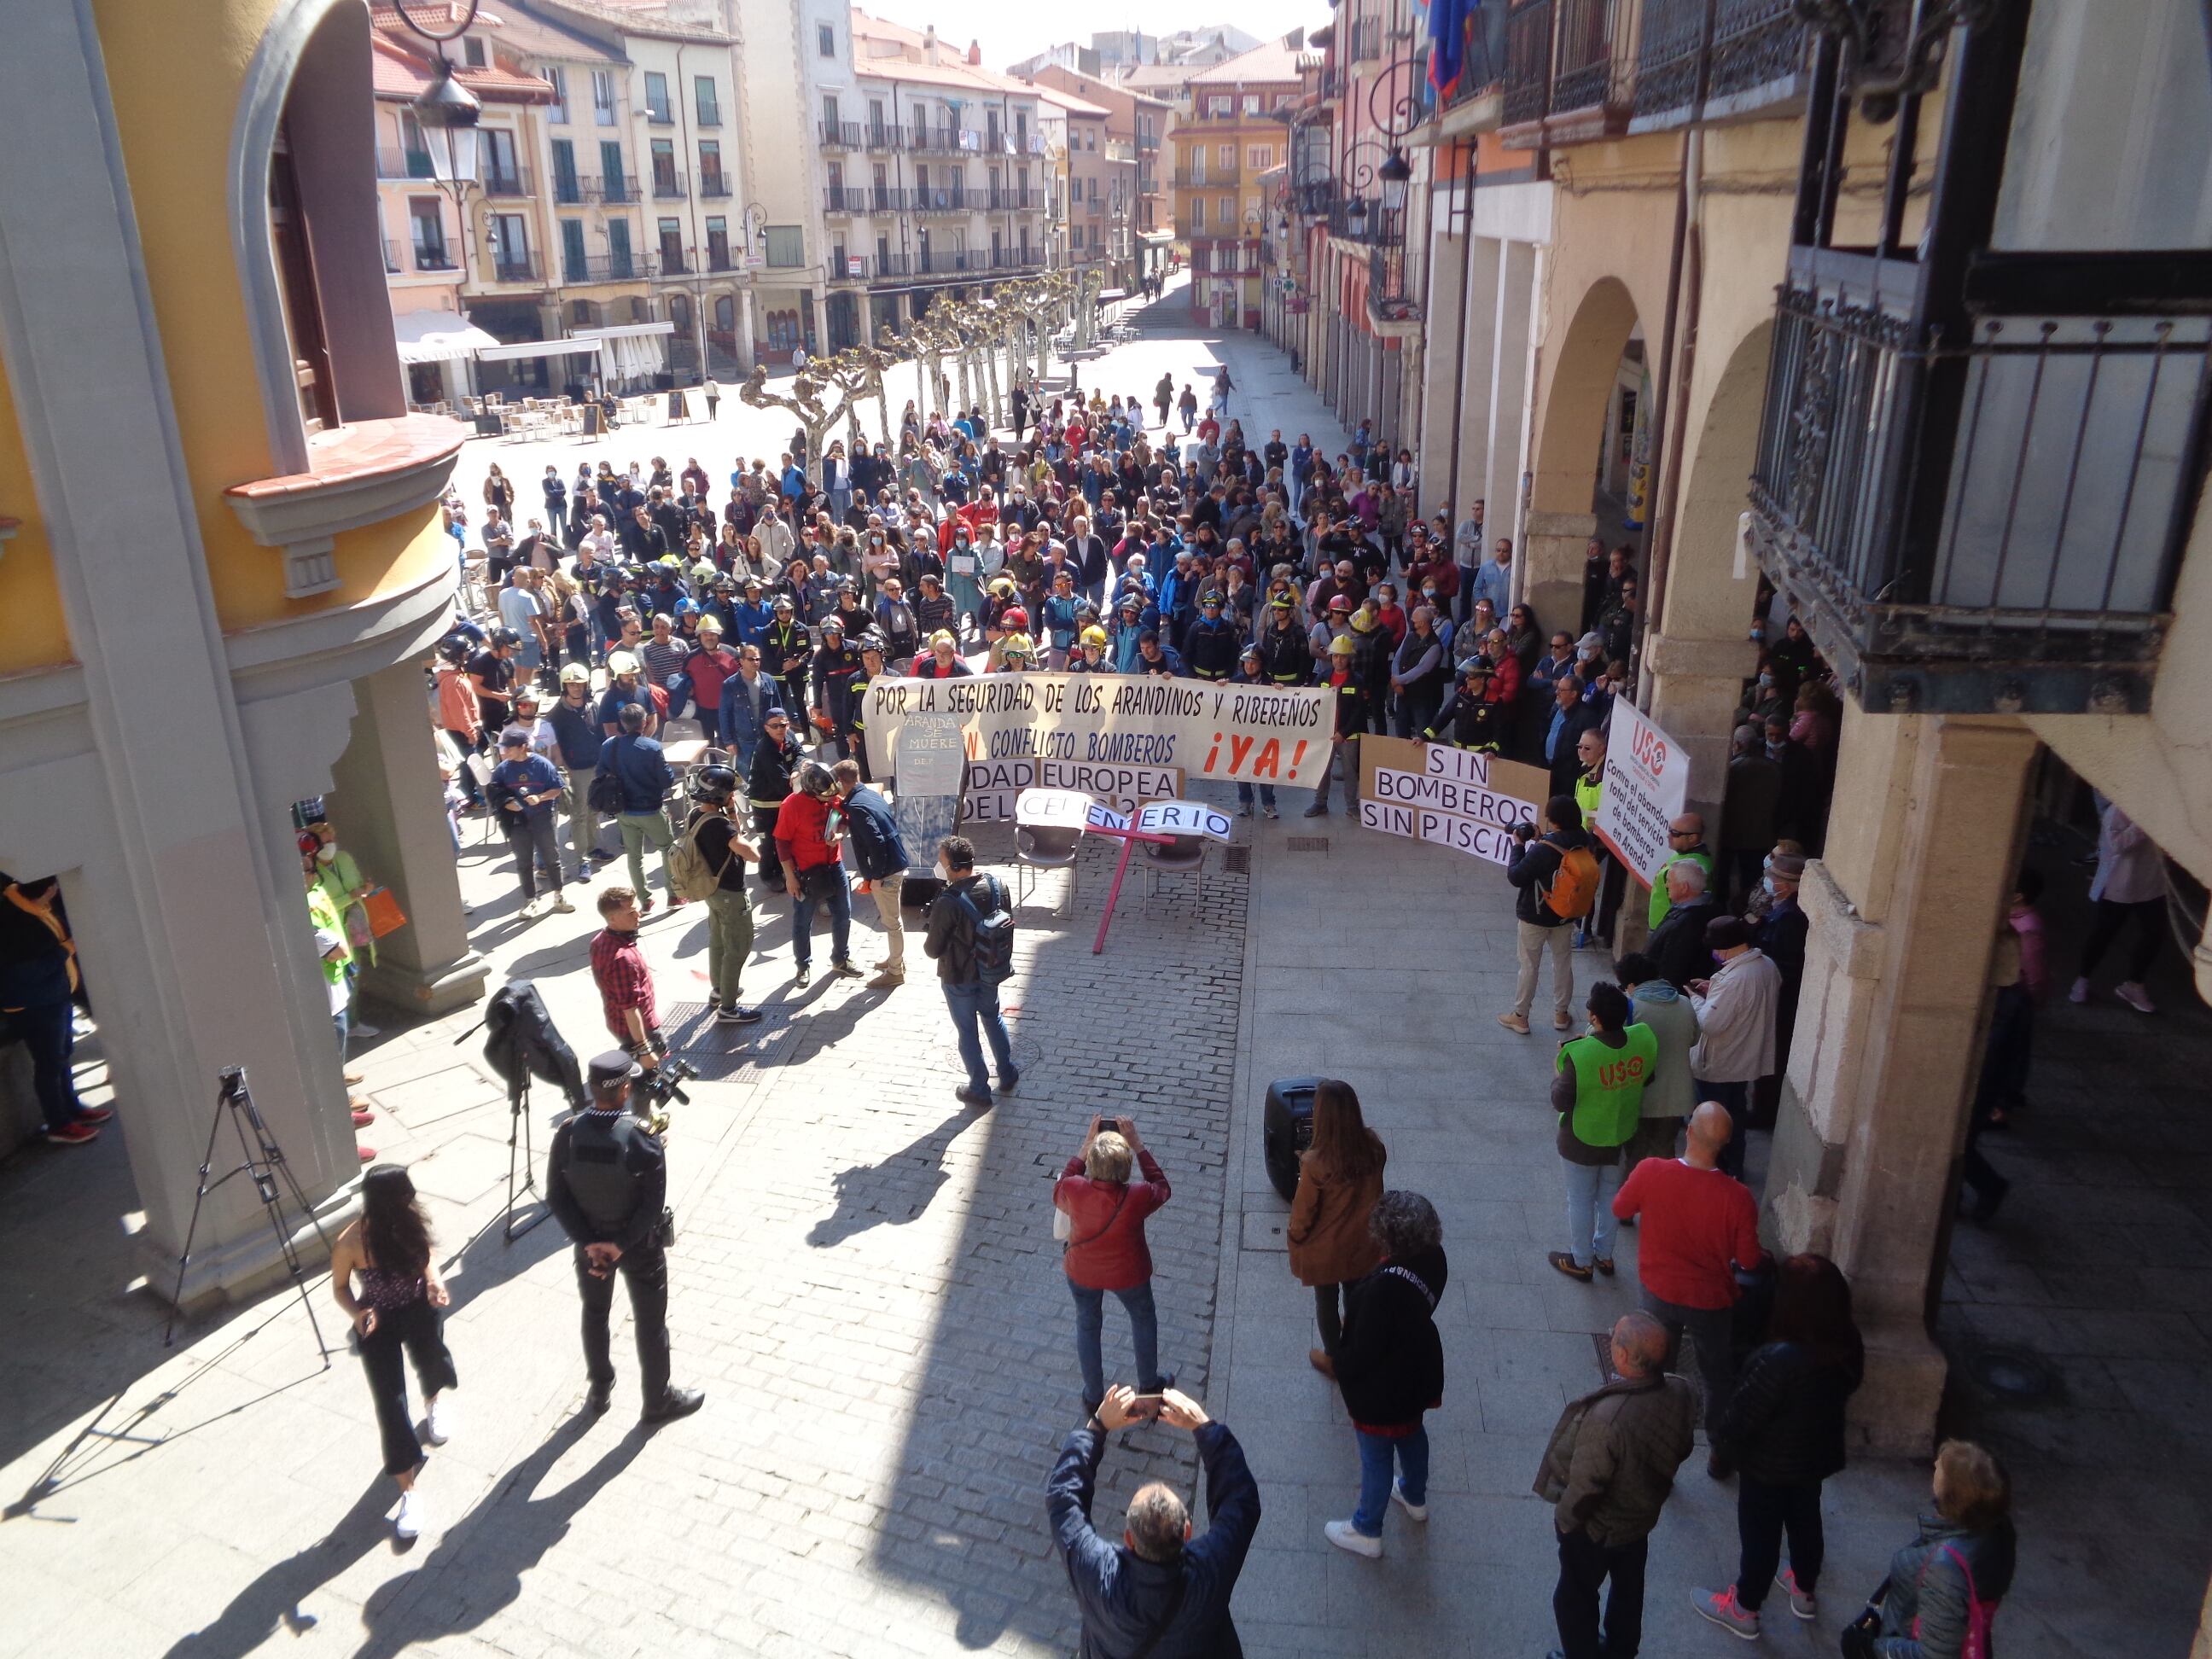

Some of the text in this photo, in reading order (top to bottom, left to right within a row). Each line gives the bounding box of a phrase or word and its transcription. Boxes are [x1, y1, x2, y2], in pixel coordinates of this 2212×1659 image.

[876, 683, 1321, 727] POR LA SEGURIDAD DE LOS ARANDINOS Y RIBEREÑOS
[905, 715, 956, 729] ARANDA
[909, 737, 957, 749] MUERE
[923, 728, 943, 737] SE
[992, 728, 1075, 760] CONFLICTO
[1087, 732, 1176, 765] BOMBEROS
[1633, 720, 1667, 777] USO
[1203, 732, 1307, 780] ¡YA!
[1429, 748, 1487, 784] SIN
[1044, 763, 1175, 798] EUROPEA
[1378, 771, 1533, 827] BOMBEROS
[1606, 758, 1630, 789] Contra
[1630, 783, 1638, 797] el
[1638, 791, 1670, 831] abandon
[1364, 803, 1514, 862] SIN PISCIN
[1609, 781, 1627, 806] total
[1627, 798, 1639, 818] del
[1638, 812, 1664, 847] servicio
[1612, 804, 1621, 821] de
[1622, 812, 1656, 859] bomberos
[1612, 827, 1648, 871] en Aranda
[1599, 1056, 1644, 1086] USO
